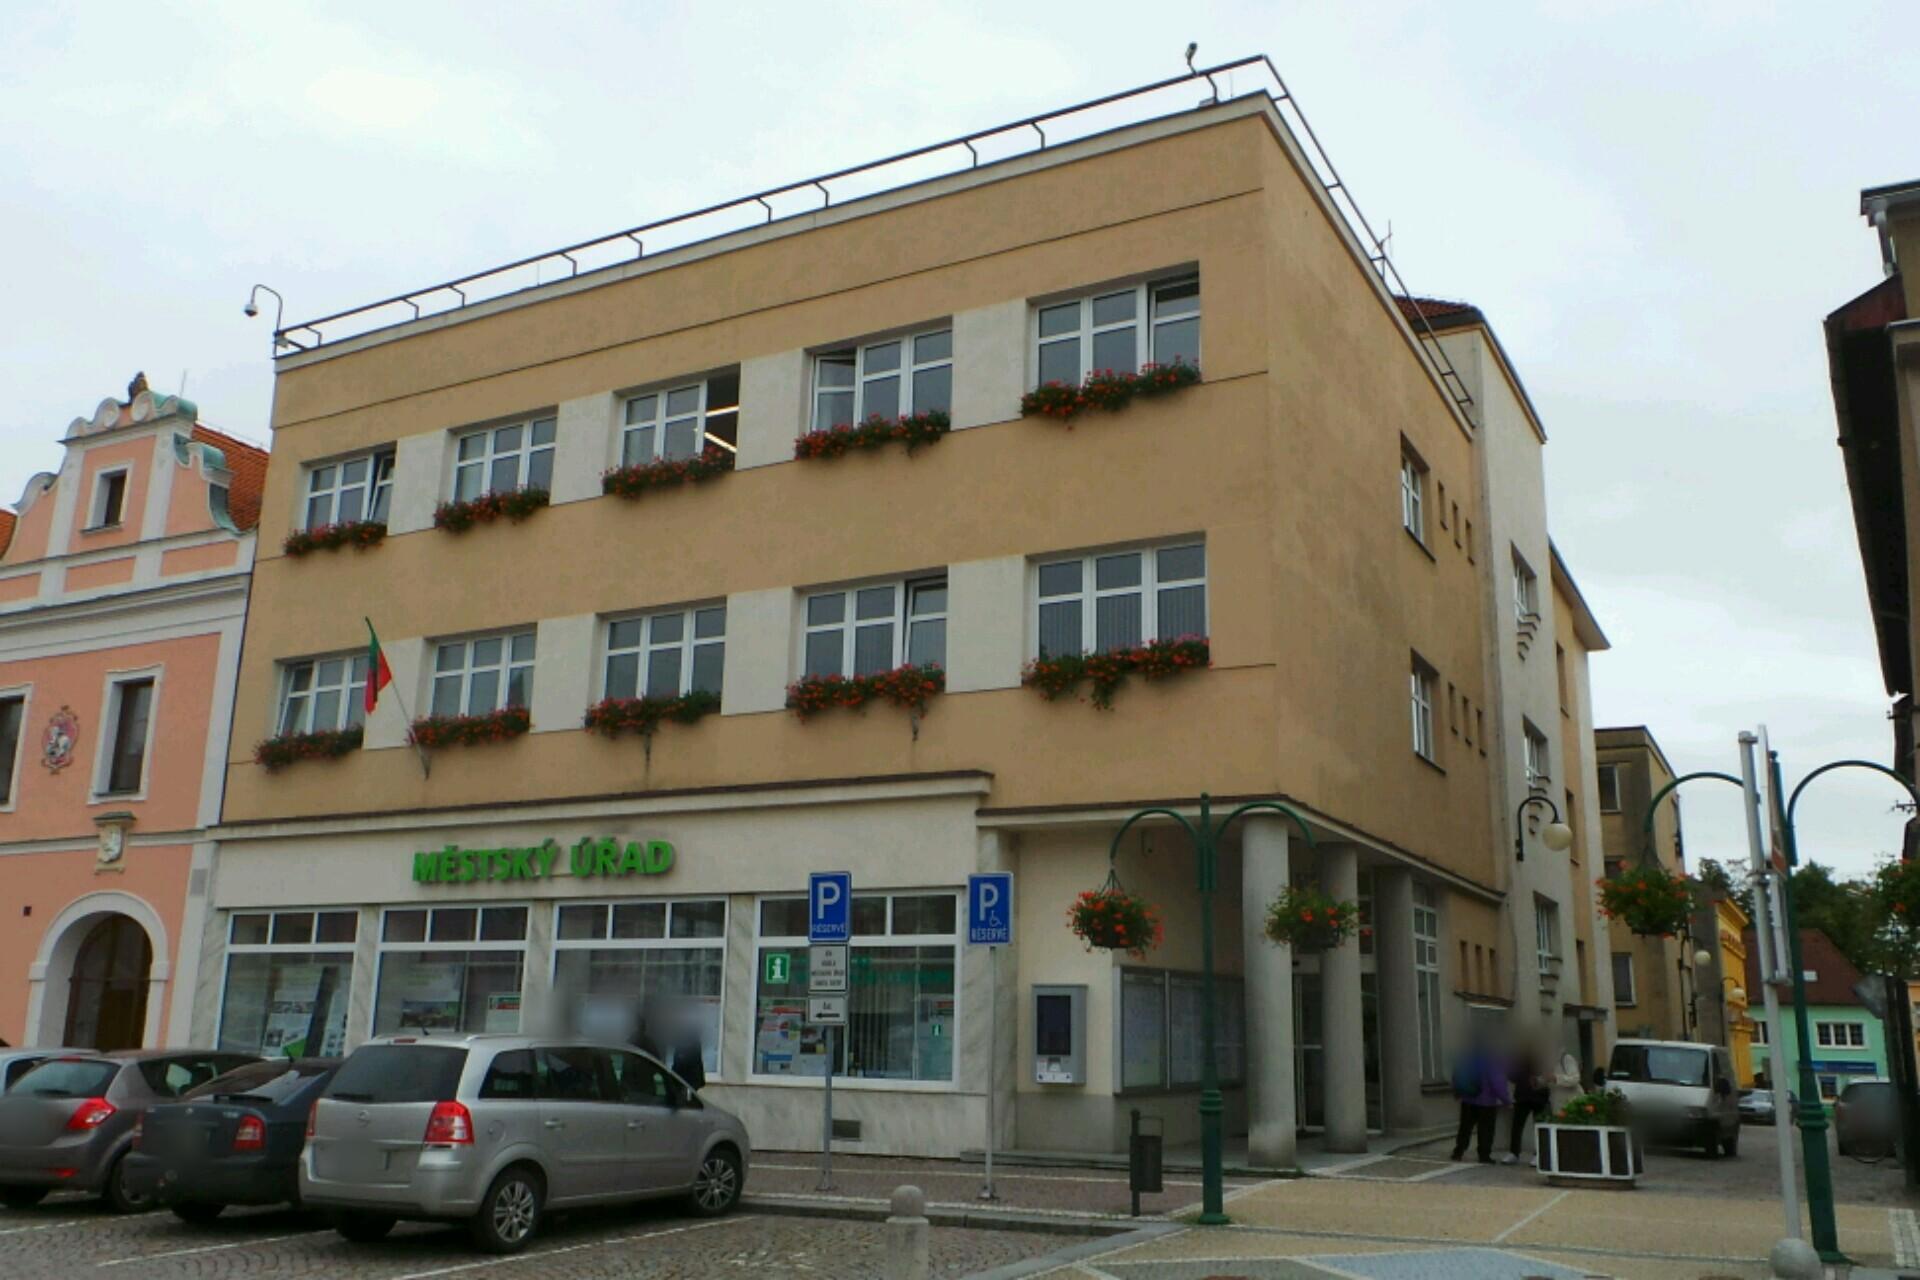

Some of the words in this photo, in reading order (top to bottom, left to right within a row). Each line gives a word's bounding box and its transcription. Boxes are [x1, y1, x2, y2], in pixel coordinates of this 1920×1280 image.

[413, 838, 560, 882] MĚSTSKÝ
[570, 837, 674, 876] ÚŘAD
[817, 881, 840, 920] P
[979, 883, 999, 921] P
